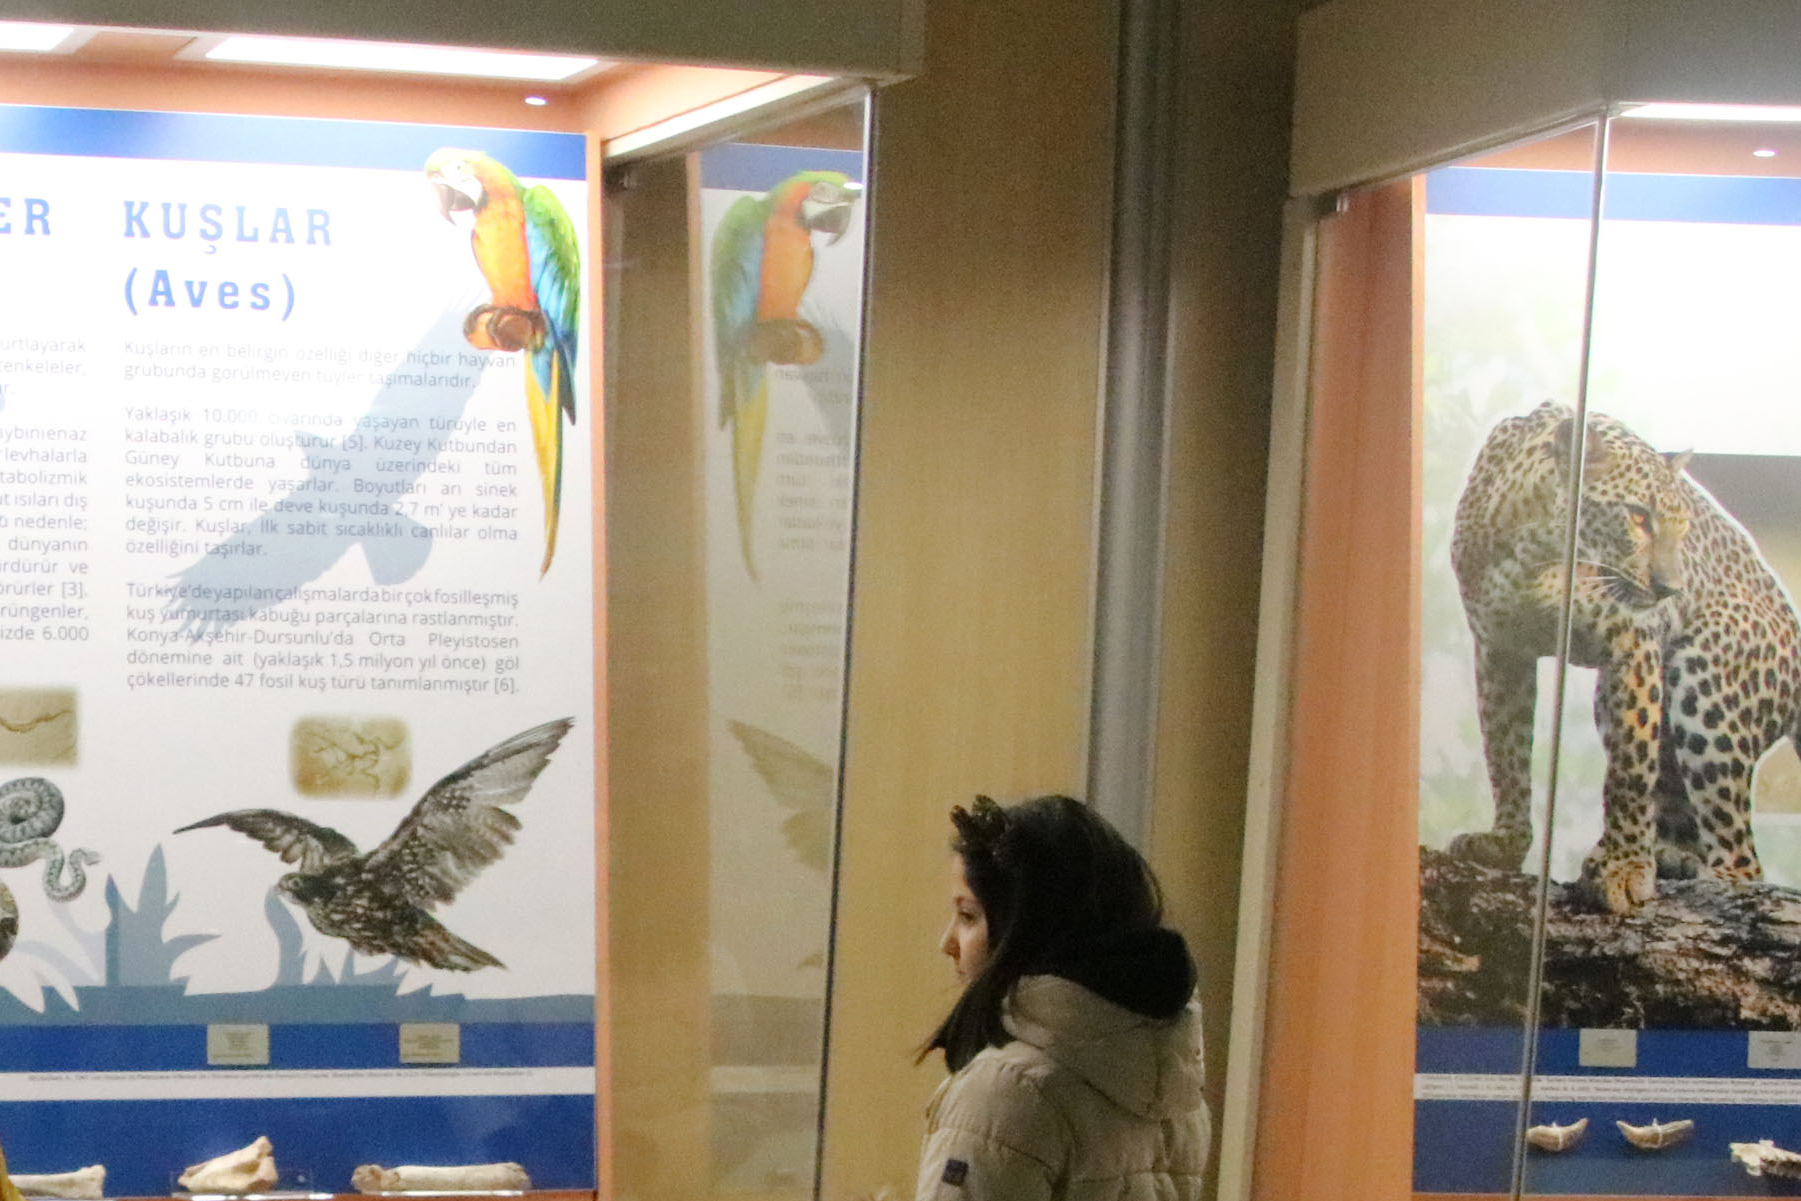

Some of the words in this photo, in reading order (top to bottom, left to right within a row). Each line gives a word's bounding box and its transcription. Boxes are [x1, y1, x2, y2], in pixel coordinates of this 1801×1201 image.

[122, 199, 333, 255] KUŞLAR
[123, 266, 298, 322] (Aves)
[124, 472, 254, 490] ekosistemlerde
[267, 476, 339, 496] yaşarlar.
[353, 478, 427, 499] Boyutları
[440, 484, 462, 496] arı
[475, 481, 518, 497] sinek
[125, 493, 198, 514] kuşunda
[203, 496, 214, 511] 5
[218, 500, 244, 512] cm
[249, 497, 270, 512] ile
[274, 497, 314, 514] deve
[318, 499, 392, 519] kuşunda
[395, 501, 419, 518] 2,7
[447, 506, 467, 522] ye
[471, 503, 518, 519] kadar
[124, 516, 186, 536] değişir.
[195, 518, 252, 538] Kuşlar,
[286, 520, 328, 536] sabit
[334, 521, 403, 538] sıcaklıklı
[410, 523, 470, 539] canlılar
[477, 524, 518, 540] olma
[7, 535, 89, 556] dünyanın
[68, 562, 90, 574] ve
[61, 580, 88, 599] [3].
[41, 625, 90, 641] 6.000
[368, 632, 406, 647] Orta
[428, 632, 520, 653] Pleyistosen
[126, 649, 213, 665] dönemine
[222, 651, 244, 666] ait
[253, 651, 325, 671] (yaklaşık
[330, 653, 355, 670] 1,5
[358, 653, 414, 672] milyon
[418, 654, 437, 673] yıl
[440, 654, 487, 673] önce)
[494, 655, 520, 674] göl
[233, 673, 255, 688] 47
[258, 673, 294, 689] fosil
[298, 674, 328, 693] kuş
[370, 675, 490, 695] tanımlanmıştır
[493, 677, 520, 695] [6].
